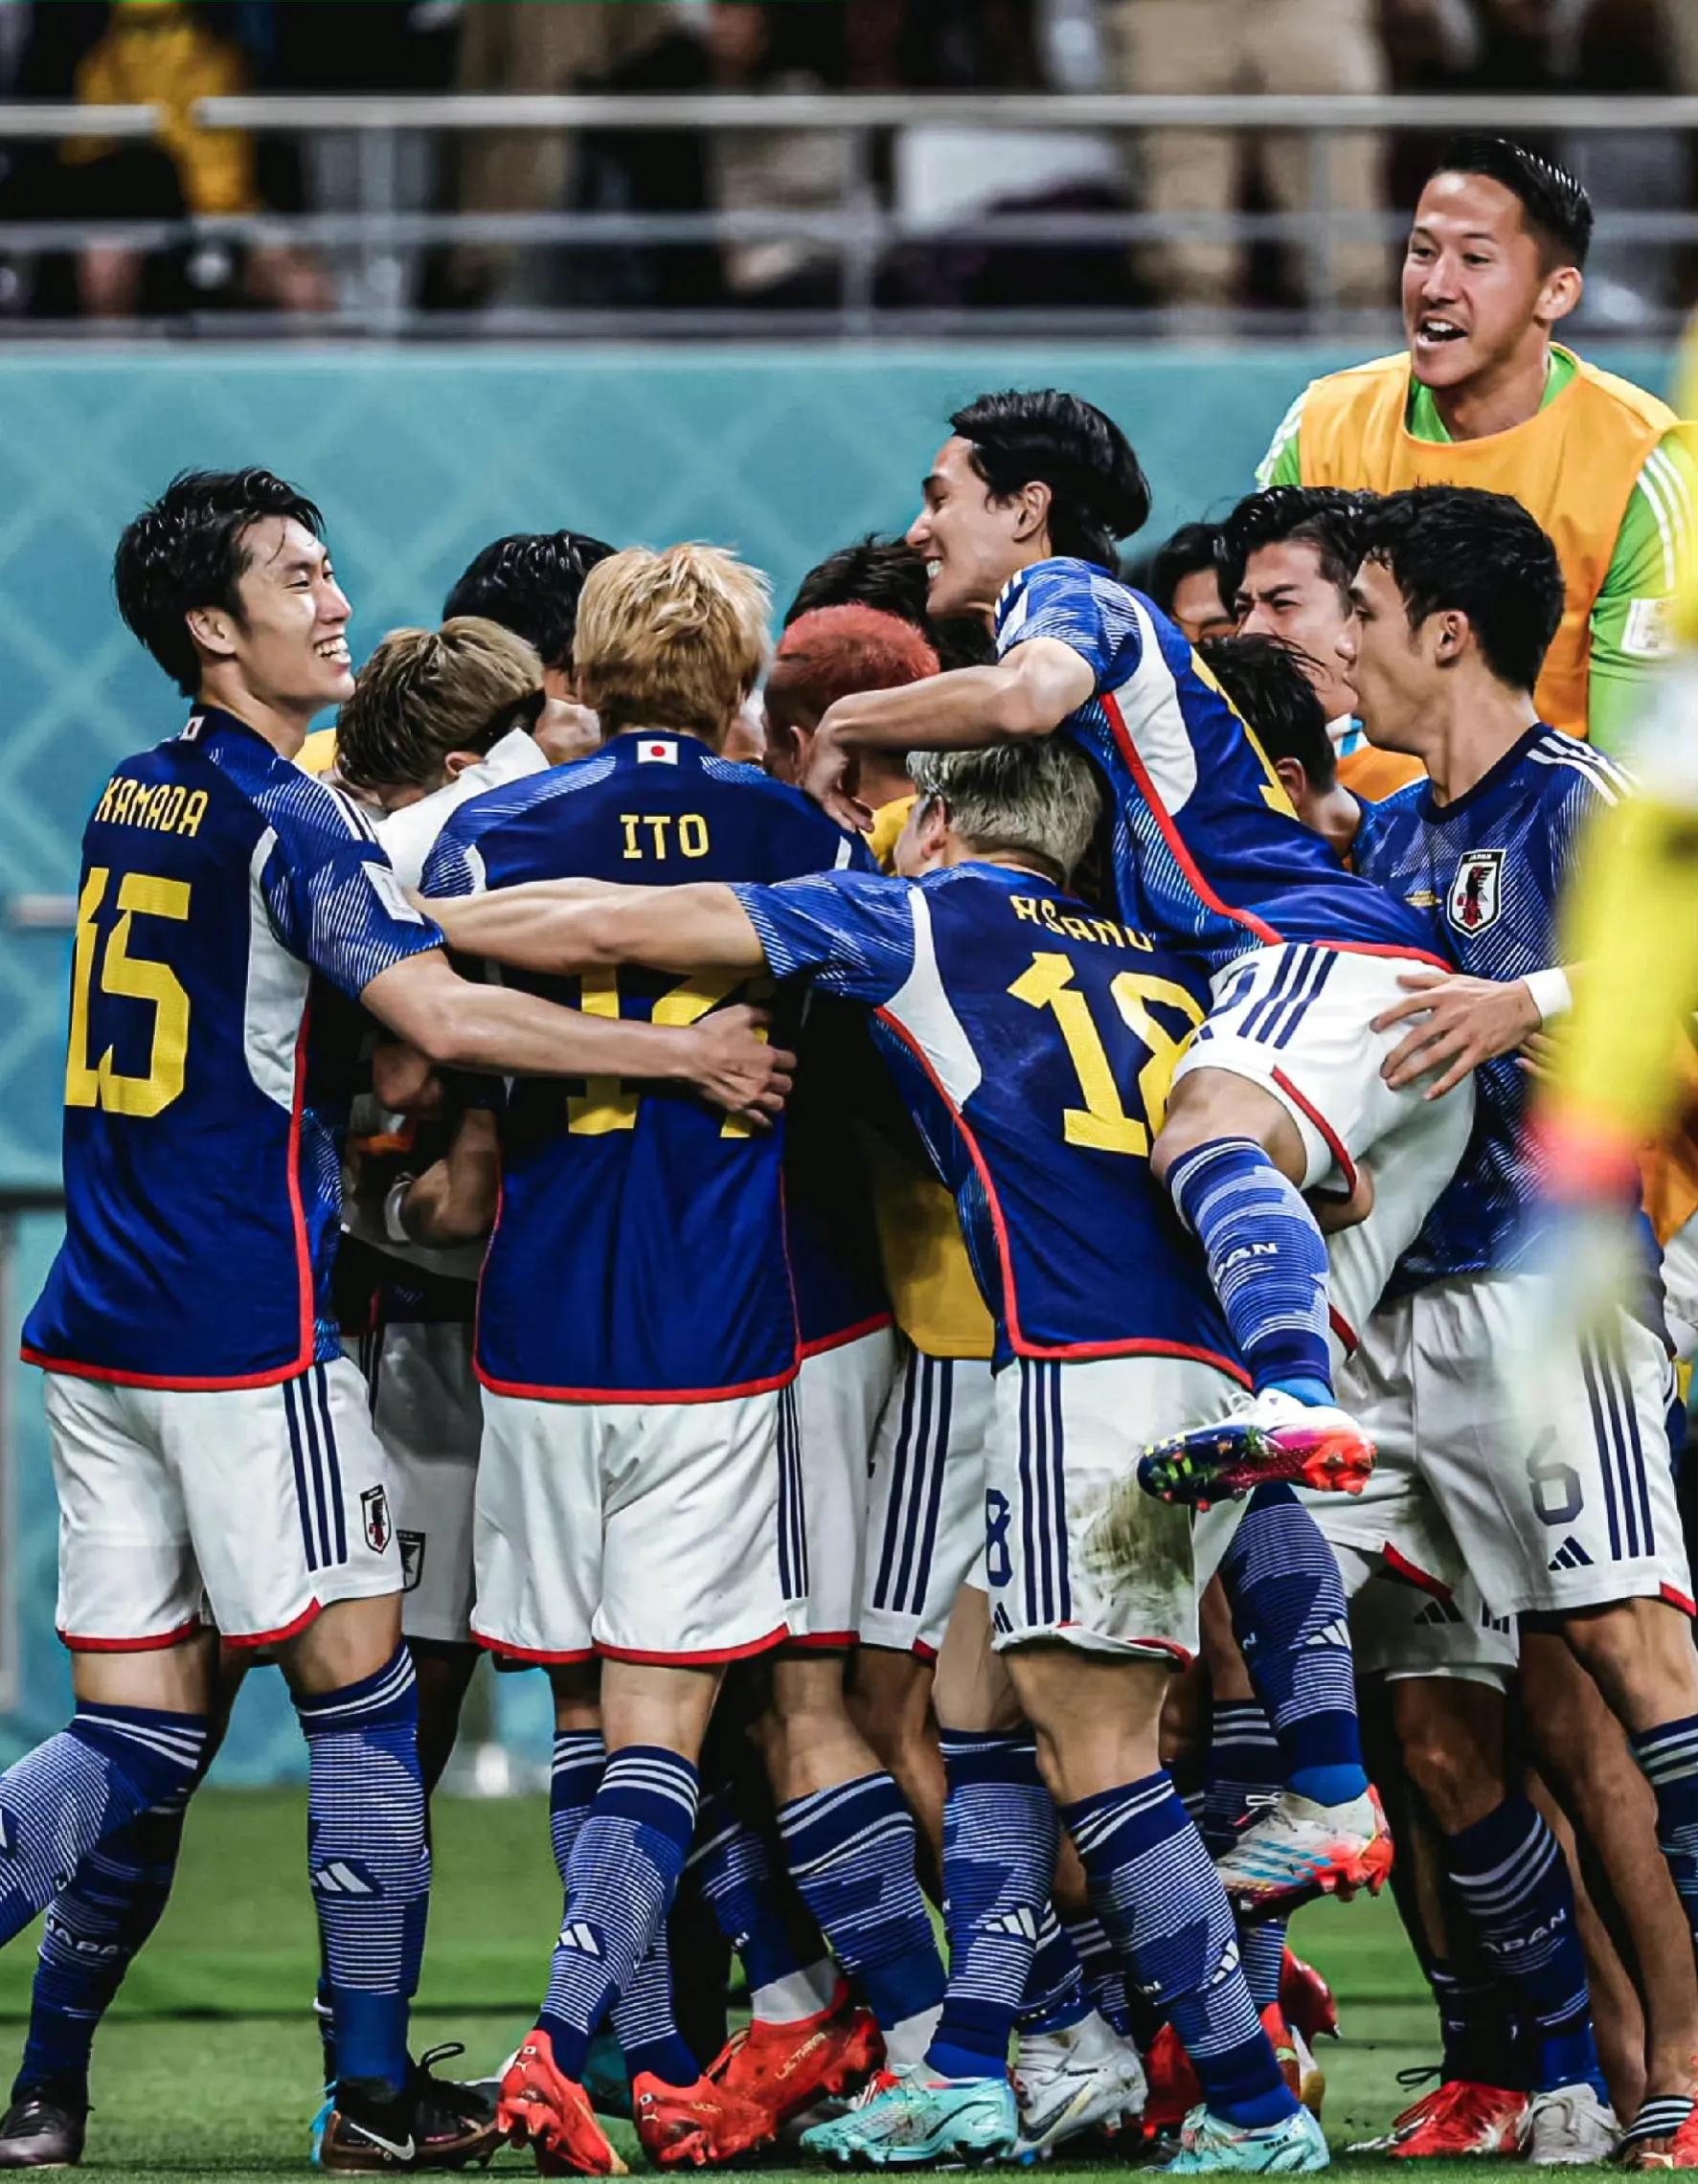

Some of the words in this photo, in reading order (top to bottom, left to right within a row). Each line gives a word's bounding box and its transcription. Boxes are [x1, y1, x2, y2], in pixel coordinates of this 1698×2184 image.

[94, 776, 209, 838] KAMADA
[620, 813, 710, 860] ITO
[63, 867, 192, 1118] 15
[1007, 951, 1206, 1158] 18
[1526, 1424, 1585, 1527] 6
